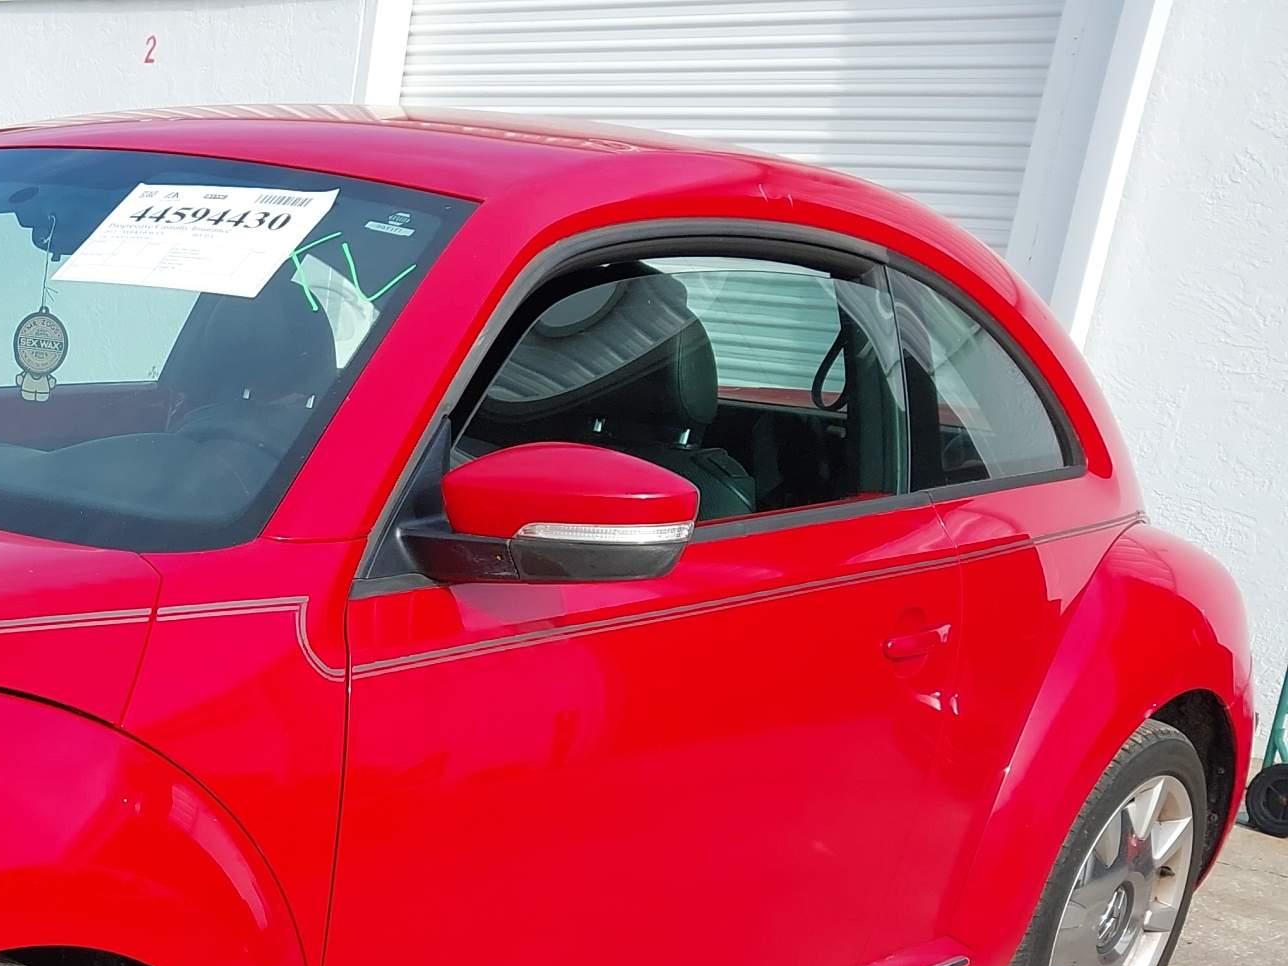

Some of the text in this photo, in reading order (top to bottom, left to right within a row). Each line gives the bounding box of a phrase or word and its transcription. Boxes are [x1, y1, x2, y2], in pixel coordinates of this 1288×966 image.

[144, 35, 157, 64] 2
[129, 205, 292, 231] 44594430
[20, 337, 61, 352] SEX WAX
